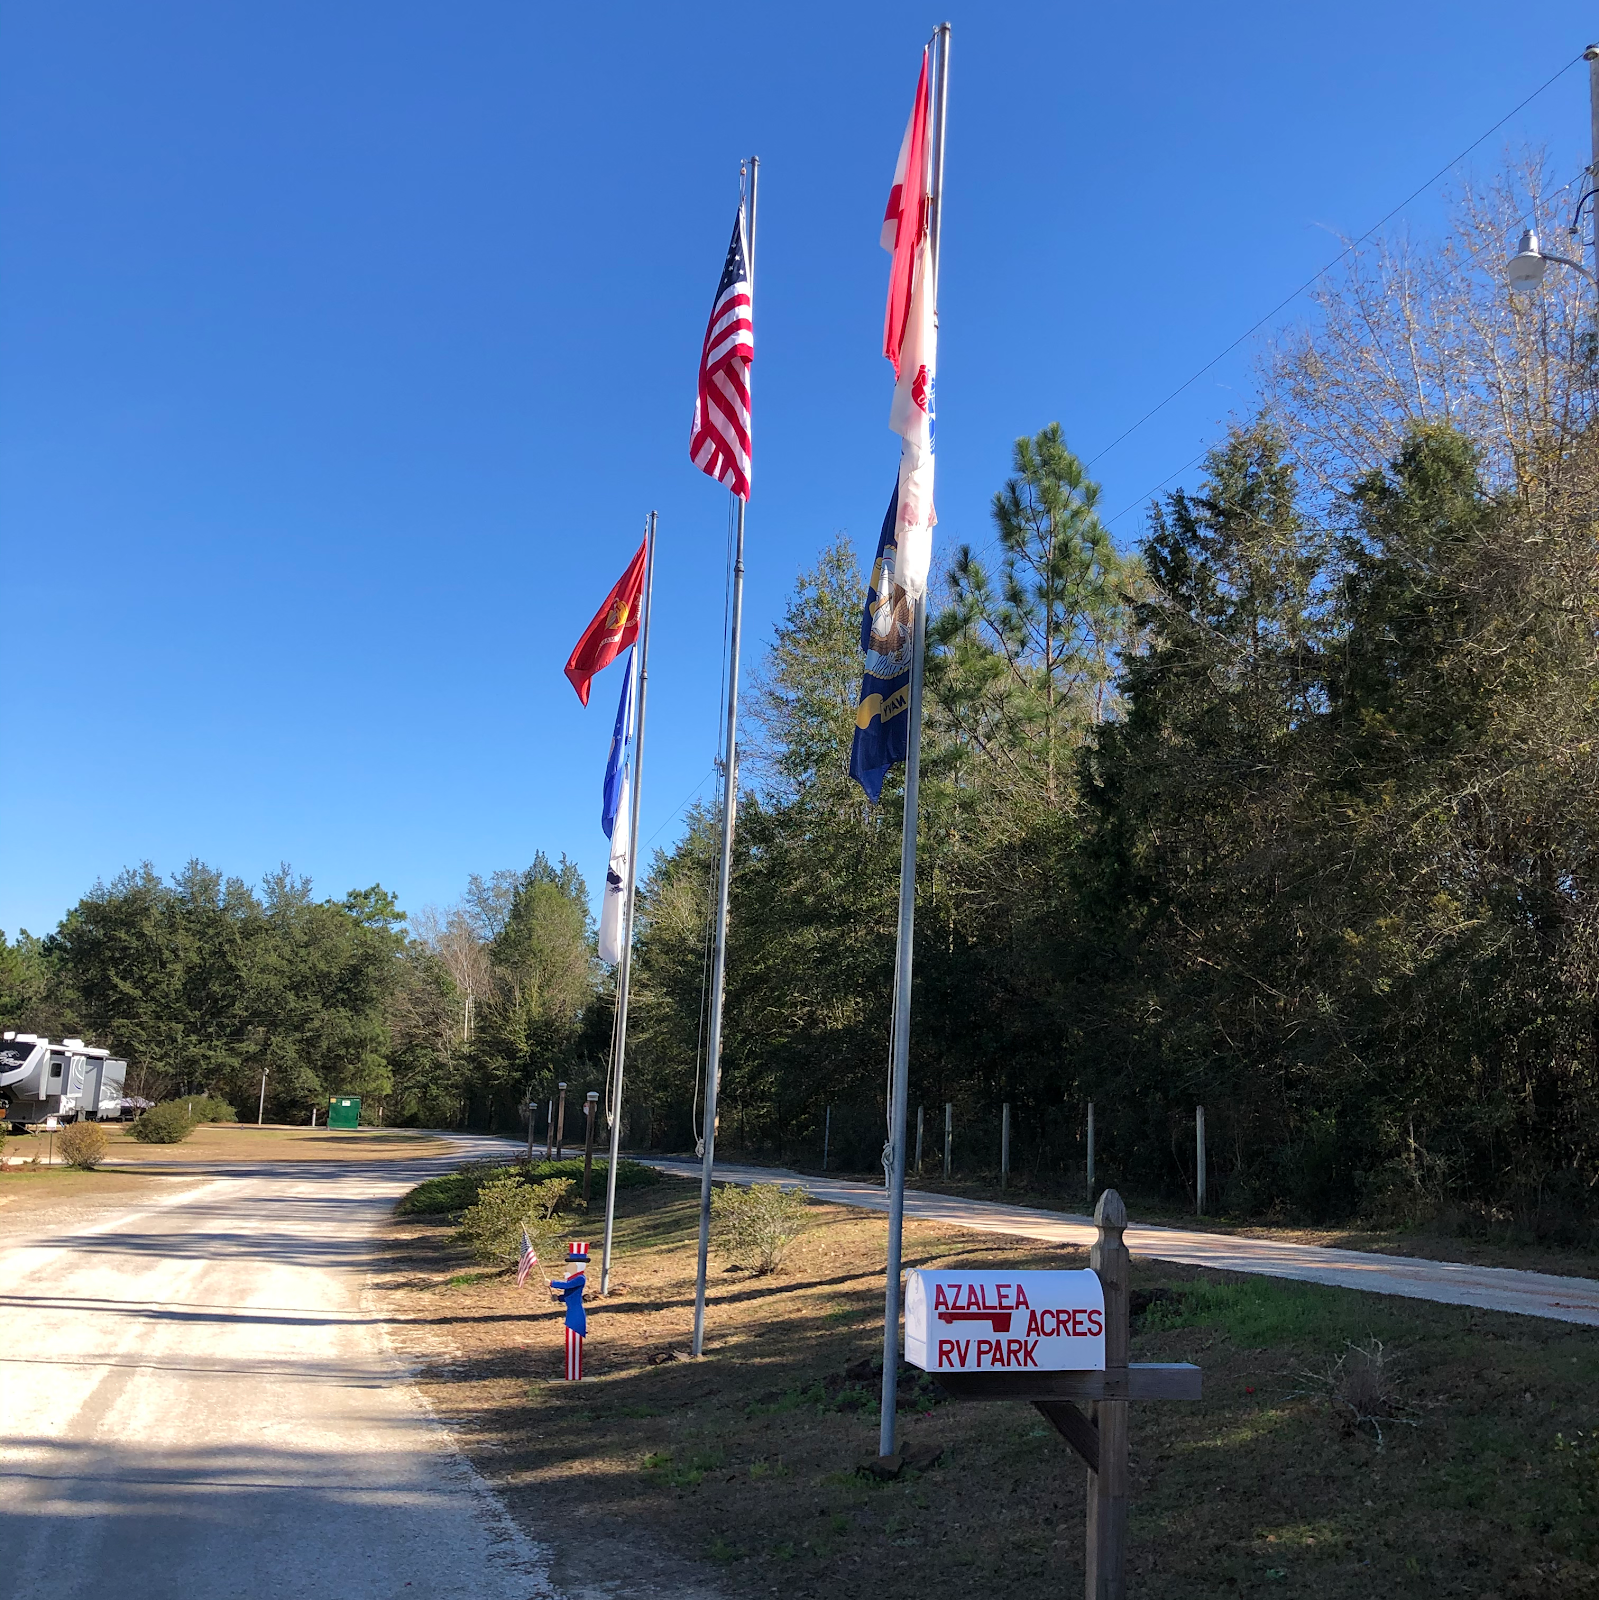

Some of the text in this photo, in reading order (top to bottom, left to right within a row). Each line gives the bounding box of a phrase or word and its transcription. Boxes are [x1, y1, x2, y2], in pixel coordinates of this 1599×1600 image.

[934, 1284, 1030, 1310] AZALEA
[1026, 1309, 1103, 1337] ACRES
[938, 1339, 1039, 1368] RV PARK
